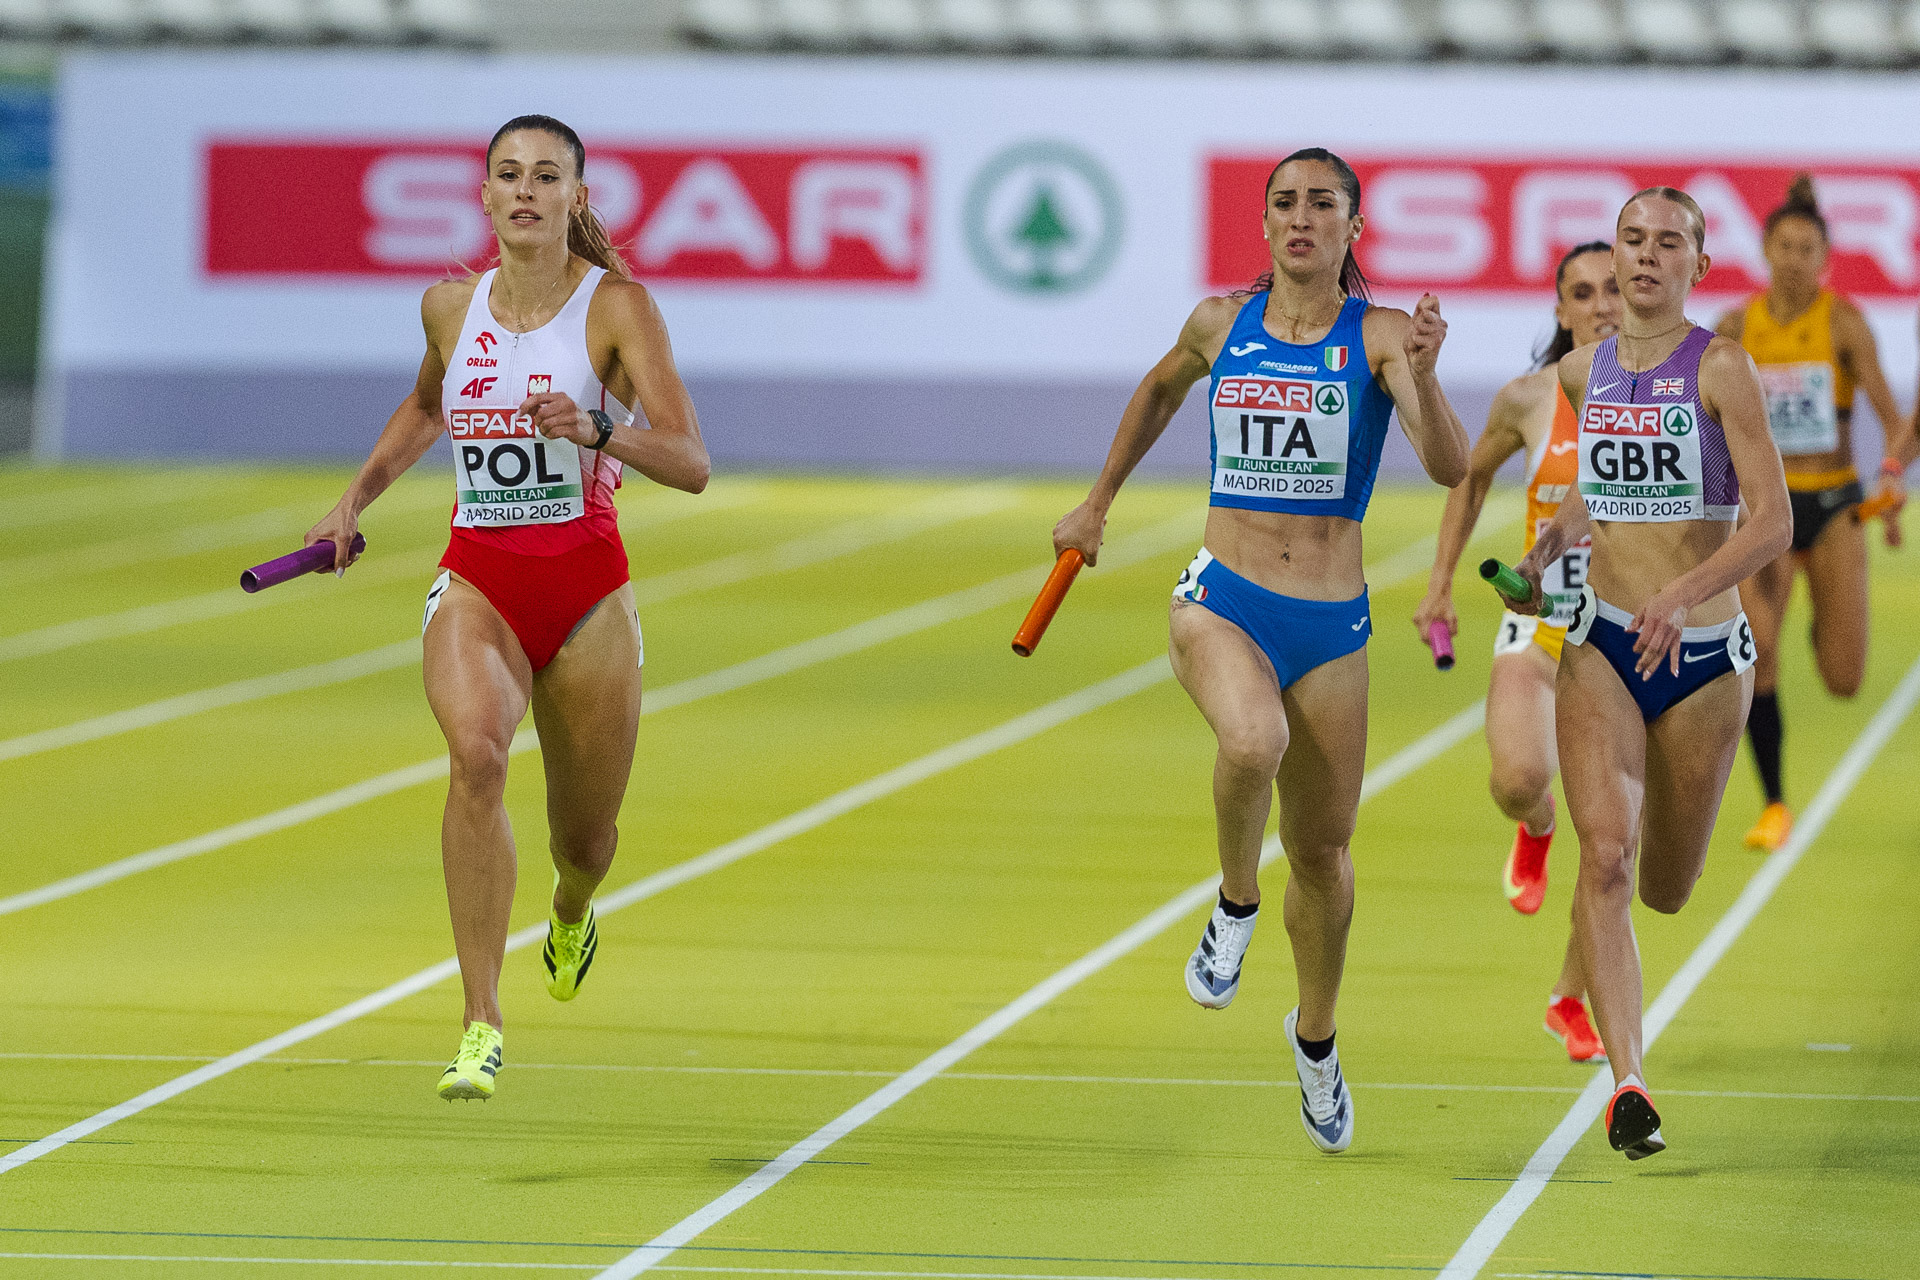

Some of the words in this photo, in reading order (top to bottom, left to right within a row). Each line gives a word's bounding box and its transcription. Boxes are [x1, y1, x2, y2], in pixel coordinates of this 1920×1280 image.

[466, 357, 498, 368] ORLEN
[1259, 360, 1318, 373] FRECCIAROSSA
[460, 377, 498, 399] 4F
[1218, 382, 1310, 409] SPAR
[452, 413, 533, 436] SPAR
[1586, 408, 1659, 433] SPAR
[1240, 414, 1318, 459] ITA
[462, 442, 564, 488] POL
[1243, 459, 1268, 472] RUN
[1590, 439, 1689, 482] GBR
[1223, 474, 1289, 493] MADRID
[1293, 479, 1334, 494] 2025
[1606, 484, 1627, 496] RUN
[477, 492, 501, 503] RUN
[1585, 499, 1647, 516] MADRID
[1651, 501, 1692, 517] 2025
[529, 503, 571, 519] 2025
[1562, 554, 1591, 589] E
[1738, 620, 1752, 661] 8
